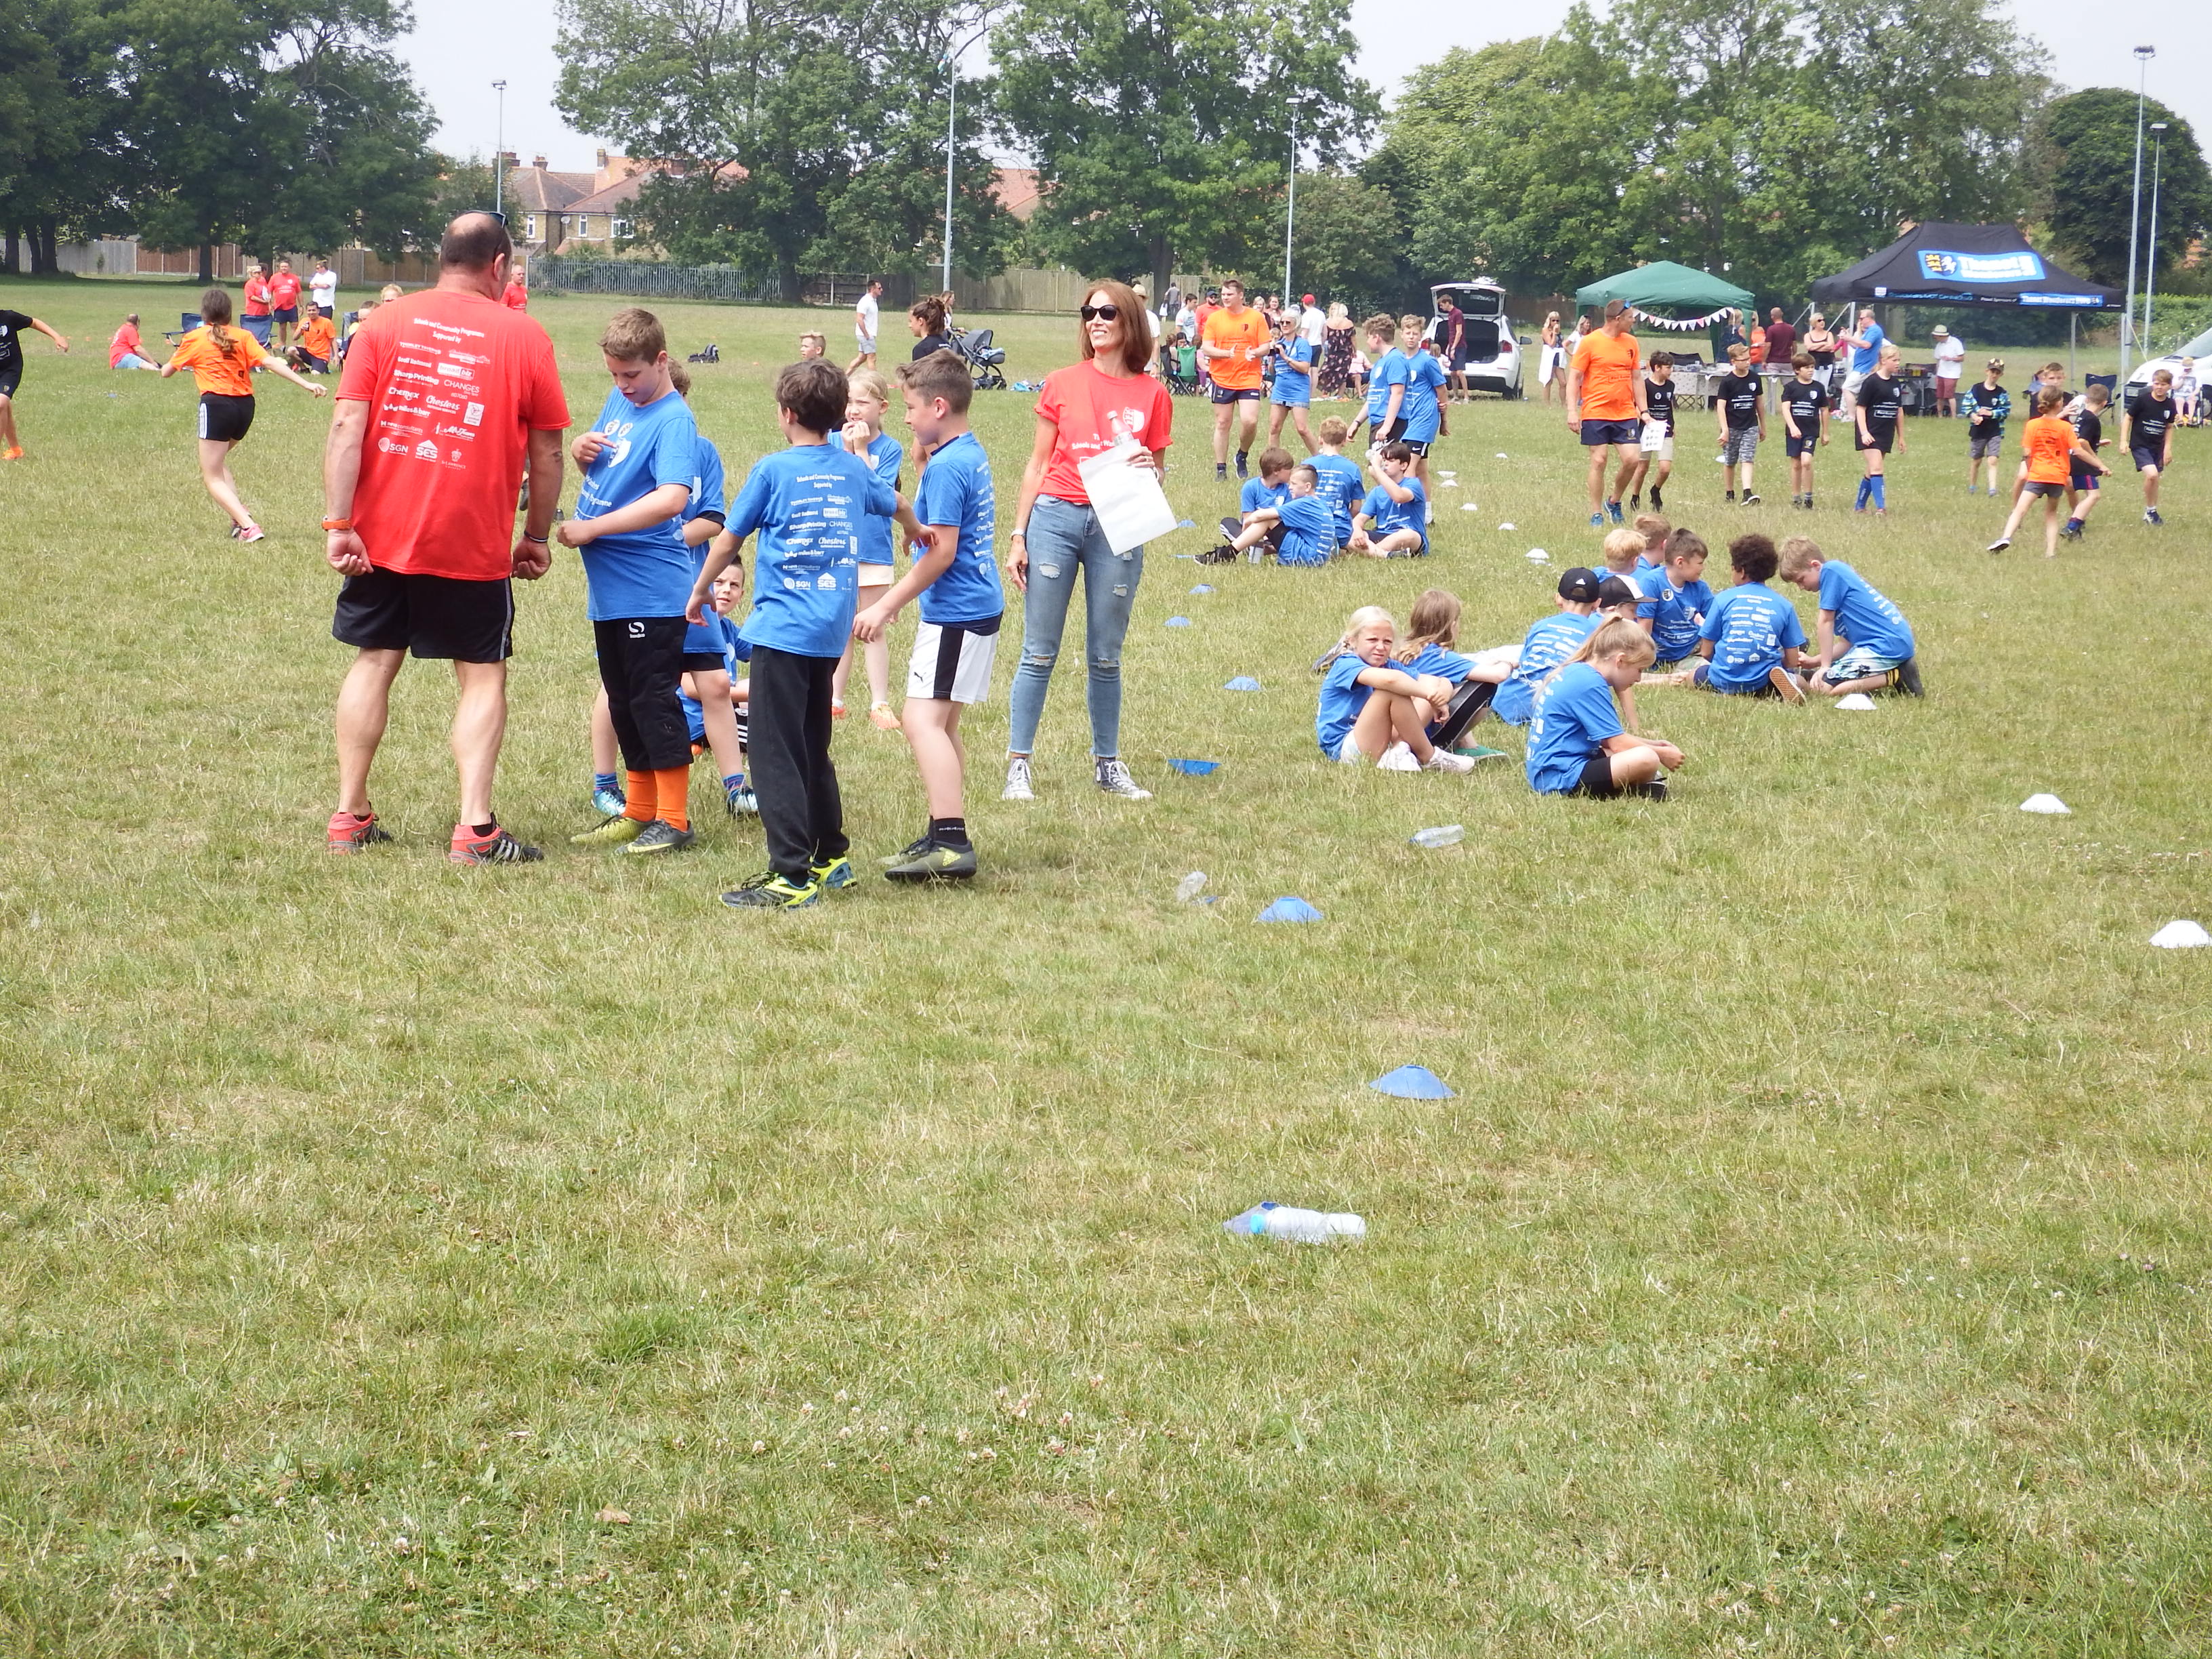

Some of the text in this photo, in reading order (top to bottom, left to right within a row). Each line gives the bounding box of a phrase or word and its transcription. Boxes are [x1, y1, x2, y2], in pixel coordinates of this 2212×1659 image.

[444, 380, 480, 394] CHANGES
[389, 443, 409, 453] SGN
[415, 447, 438, 459] SES
